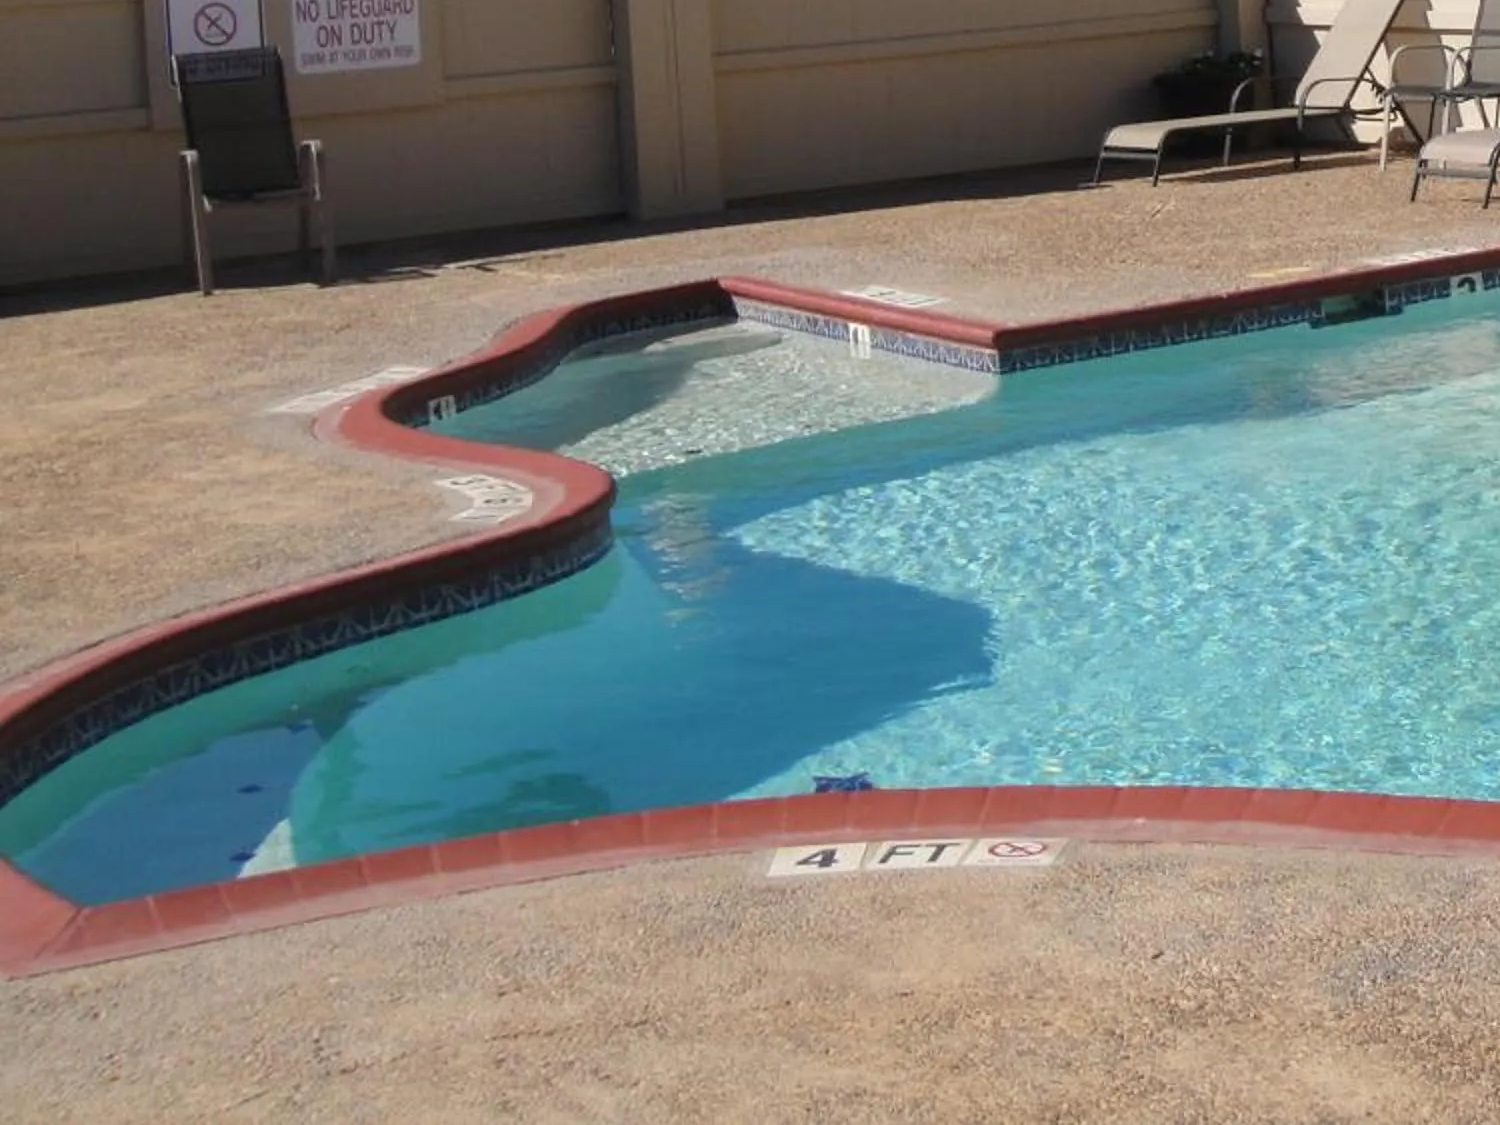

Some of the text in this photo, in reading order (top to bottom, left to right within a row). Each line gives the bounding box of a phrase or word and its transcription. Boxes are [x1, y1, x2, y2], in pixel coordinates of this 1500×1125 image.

[317, 19, 397, 48] ON DUTY
[796, 842, 961, 868] 4 FT
